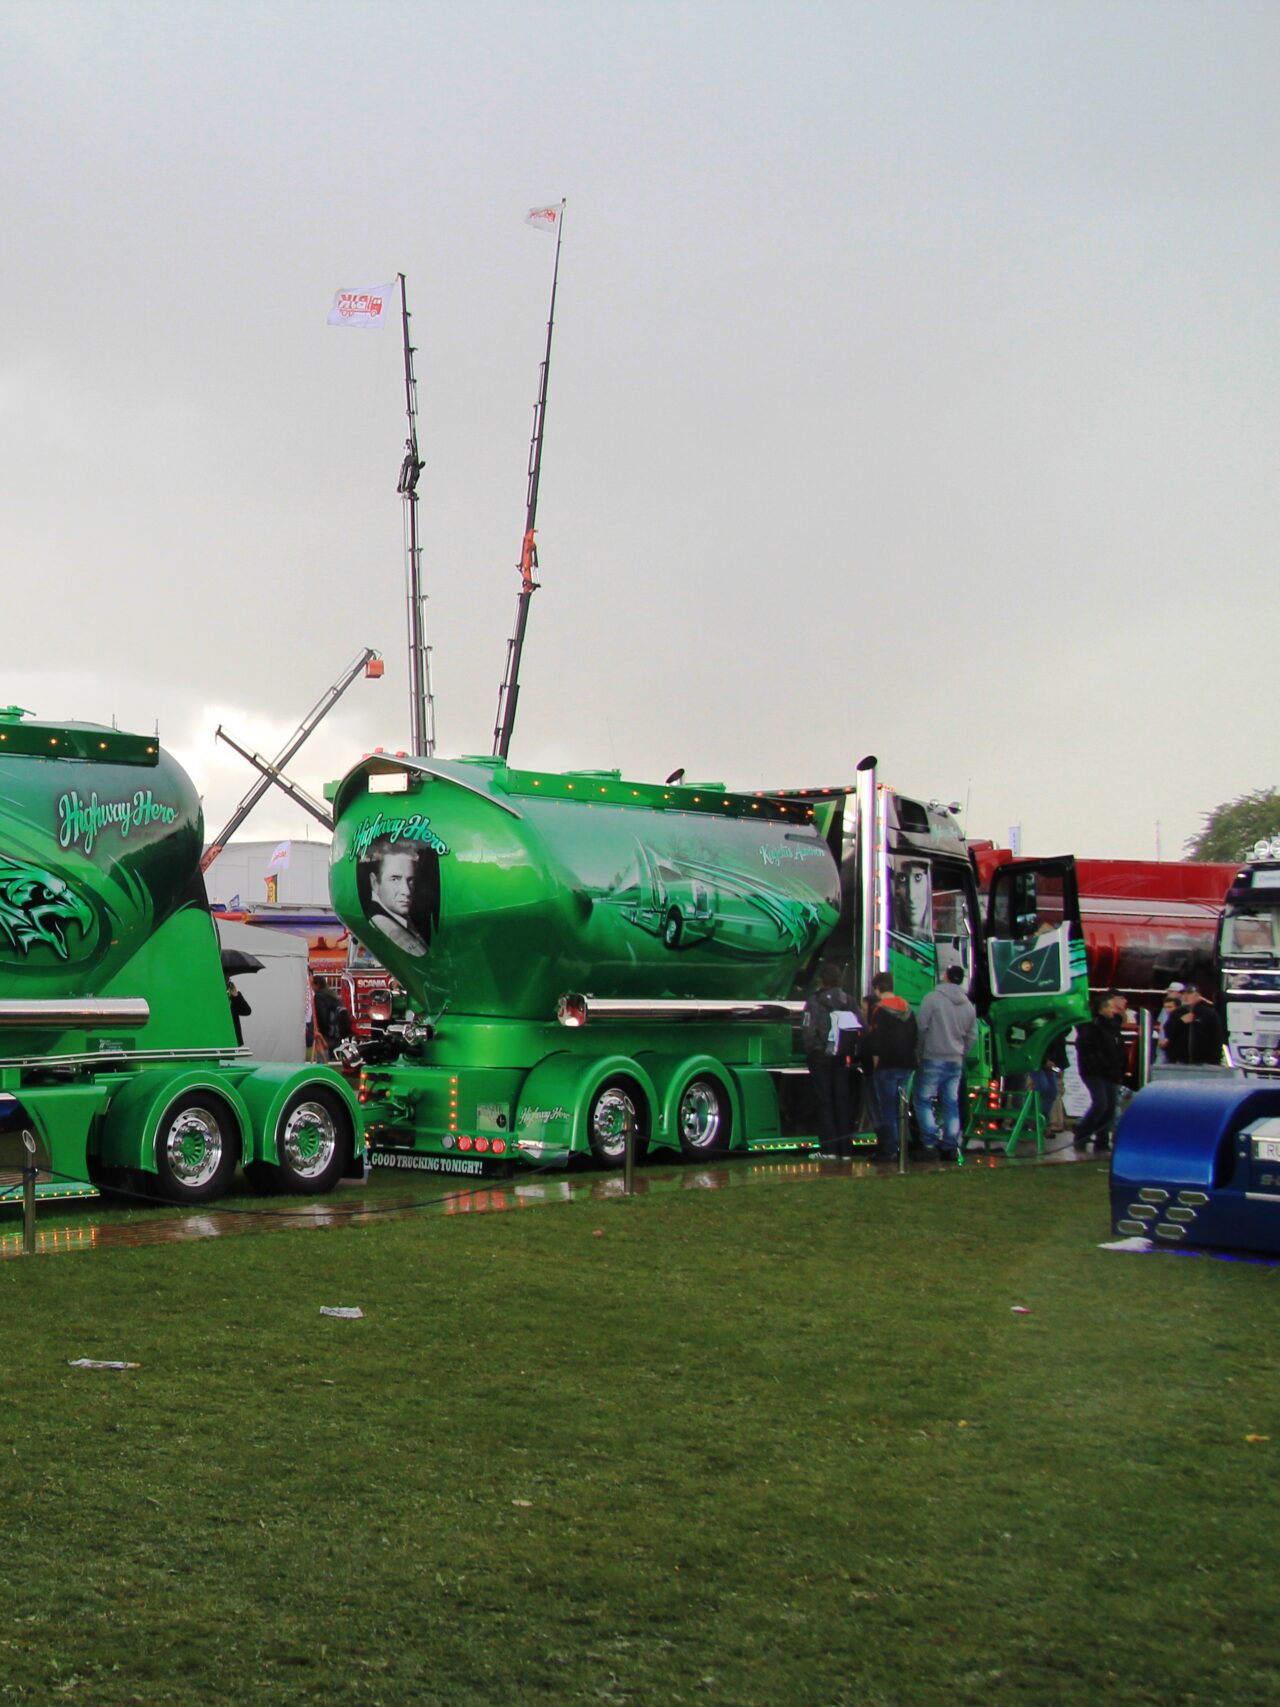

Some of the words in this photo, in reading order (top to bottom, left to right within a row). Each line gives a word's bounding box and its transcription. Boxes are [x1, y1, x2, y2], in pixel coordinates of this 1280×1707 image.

[59, 791, 132, 854] Highway
[133, 790, 179, 825] Hero
[349, 812, 406, 861] Highway
[402, 814, 449, 856] Hero
[357, 979, 387, 988] SCANIA
[371, 1152, 396, 1167] GOOD
[396, 1154, 440, 1171] TRUCKING
